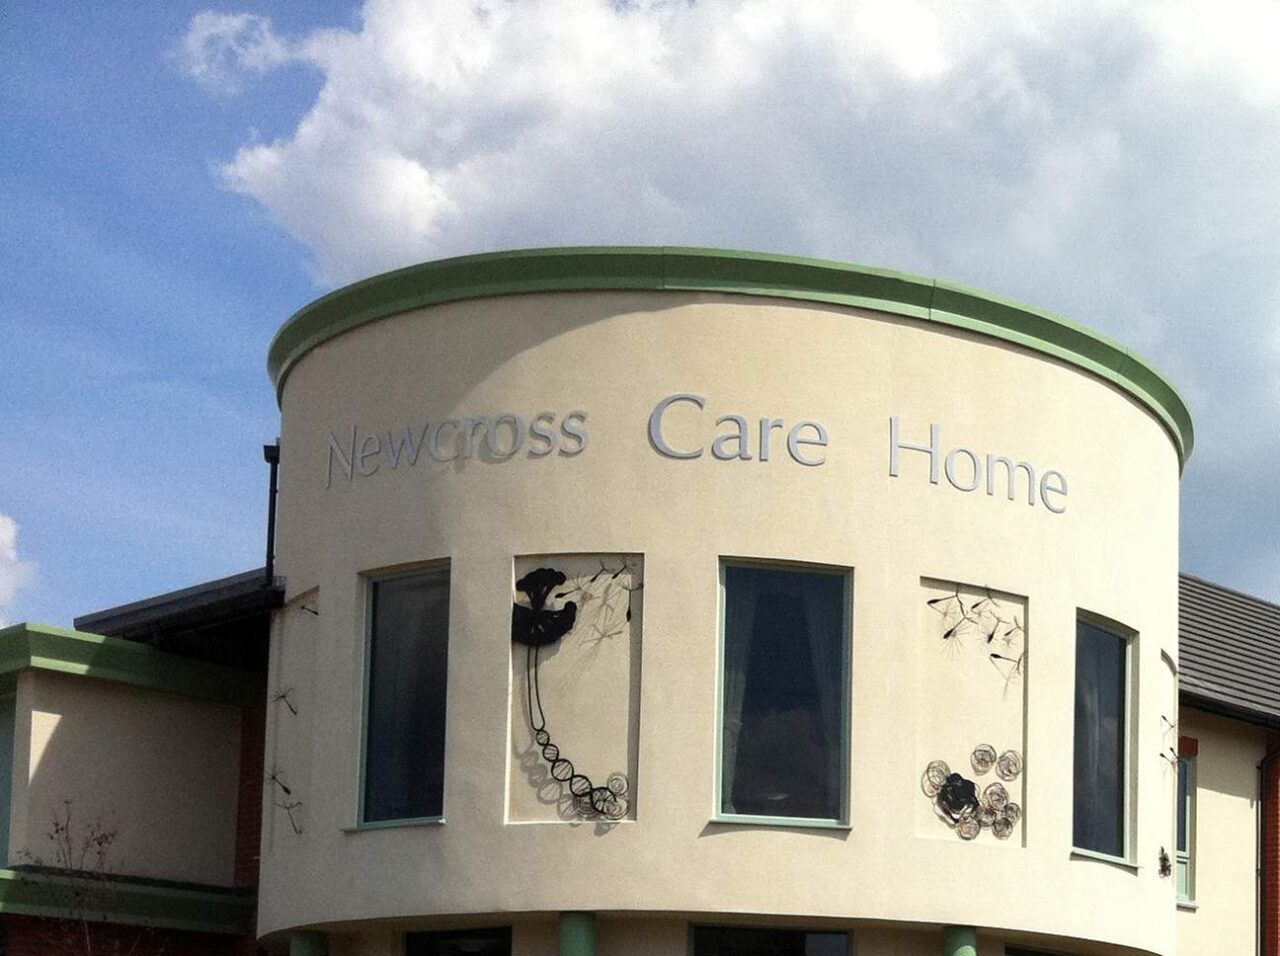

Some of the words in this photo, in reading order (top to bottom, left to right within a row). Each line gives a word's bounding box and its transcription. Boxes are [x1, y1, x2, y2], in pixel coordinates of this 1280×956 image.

[326, 410, 588, 489] Newcross
[648, 393, 828, 466] Care
[889, 416, 1068, 513] Home
